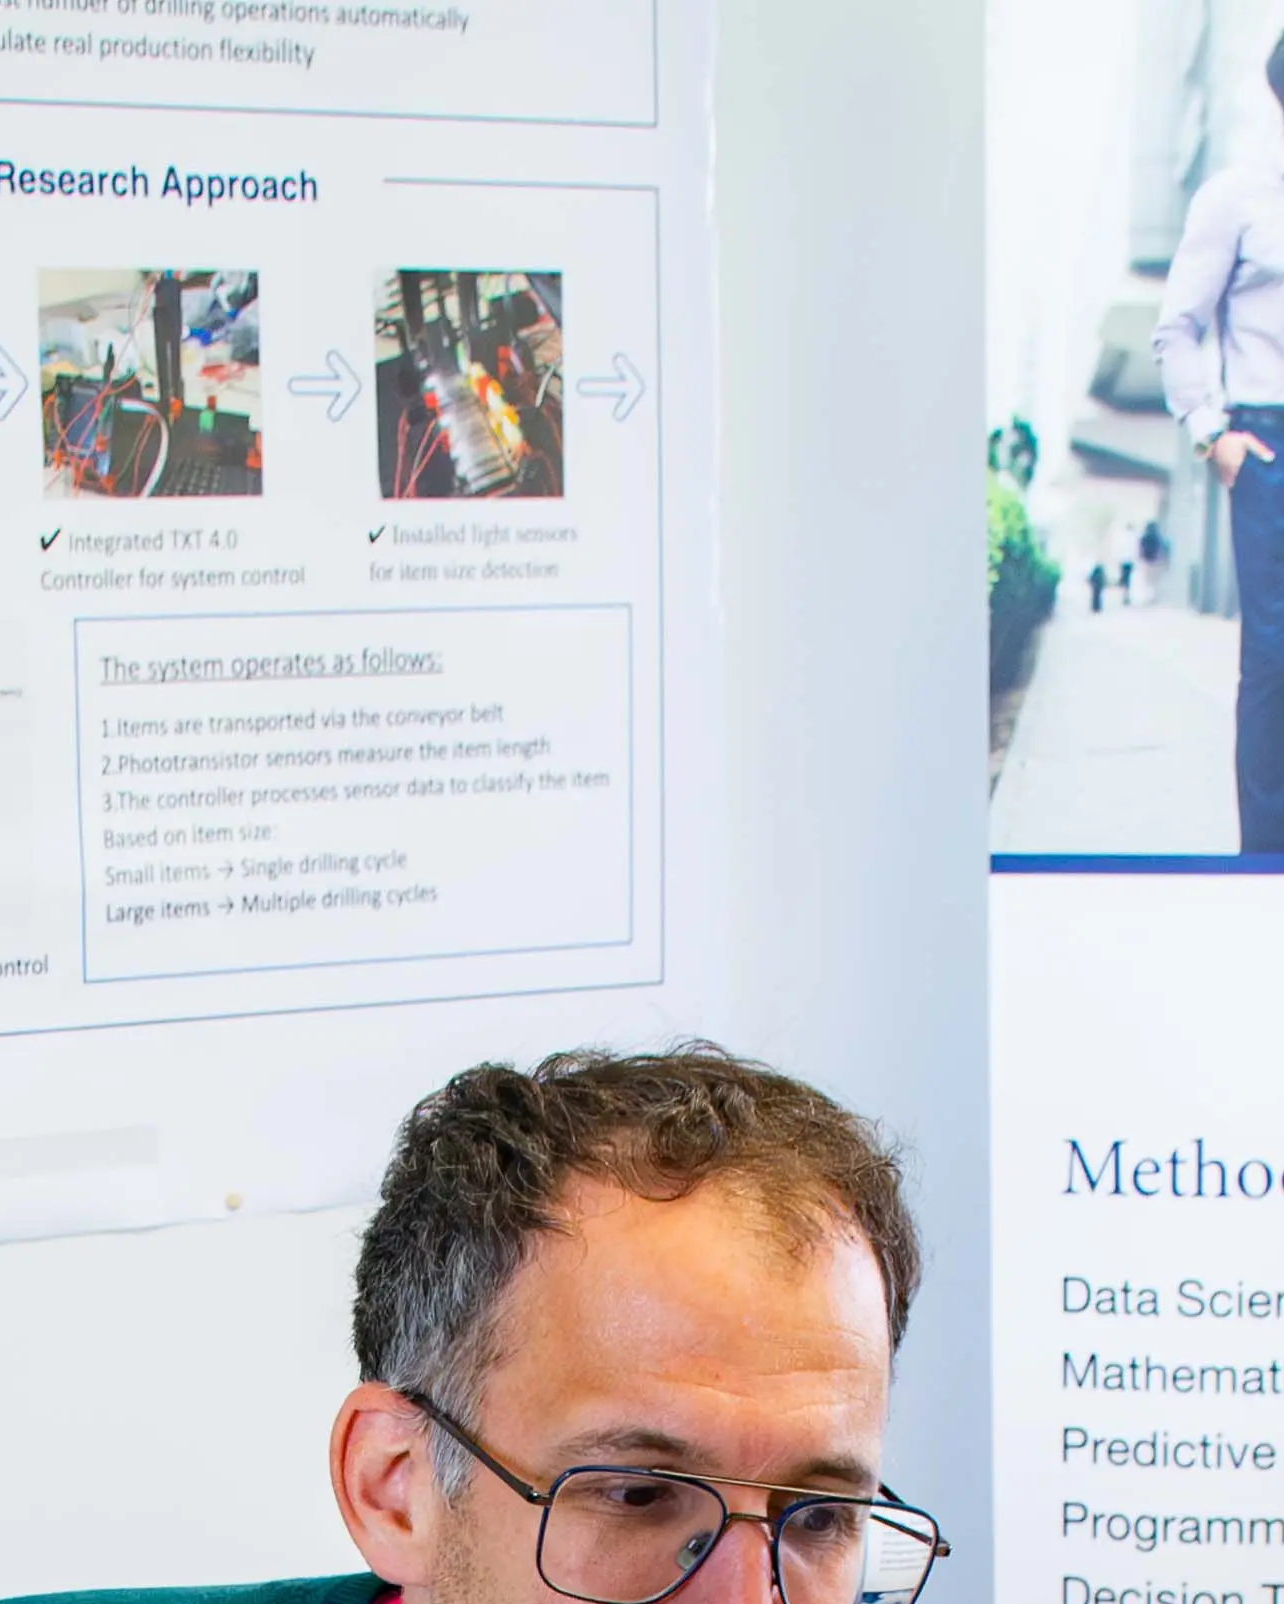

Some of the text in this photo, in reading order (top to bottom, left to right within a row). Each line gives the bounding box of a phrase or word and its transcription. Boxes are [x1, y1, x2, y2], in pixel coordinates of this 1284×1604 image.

[221, 3, 329, 27] operations
[335, 8, 470, 35] automatically
[53, 32, 93, 55] real
[99, 36, 213, 64] production
[218, 39, 316, 70] flexibility
[161, 166, 318, 207] Approach
[68, 529, 239, 555] Integrated TXT 4.0
[392, 523, 578, 547] Installed light sensors
[40, 565, 306, 592] Controller for system control
[369, 558, 559, 582] for item size detection
[100, 646, 444, 684] The system operates as follows:
[174, 717, 204, 738] are
[208, 710, 316, 738] transported
[321, 707, 347, 730] via
[351, 705, 382, 729] the
[385, 705, 465, 733] conveyor
[470, 702, 505, 725] belt
[101, 735, 551, 777] 2.Phototransistor sensors measure the item length
[157, 783, 245, 810] controller
[250, 781, 339, 807] processes
[343, 778, 401, 801] sensor
[406, 774, 445, 797] data
[450, 773, 468, 796] to
[472, 769, 534, 796] classify
[538, 767, 567, 790] the
[570, 767, 611, 788] item
[103, 827, 161, 850] Based
[165, 828, 189, 847] on
[192, 823, 234, 846] item
[104, 848, 408, 887] Small items Single drilling cycle
[105, 882, 438, 927] Large items Multiple drilling cycles
[1061, 1276, 1161, 1318] Data
[1061, 1427, 1277, 1471] Predictive
